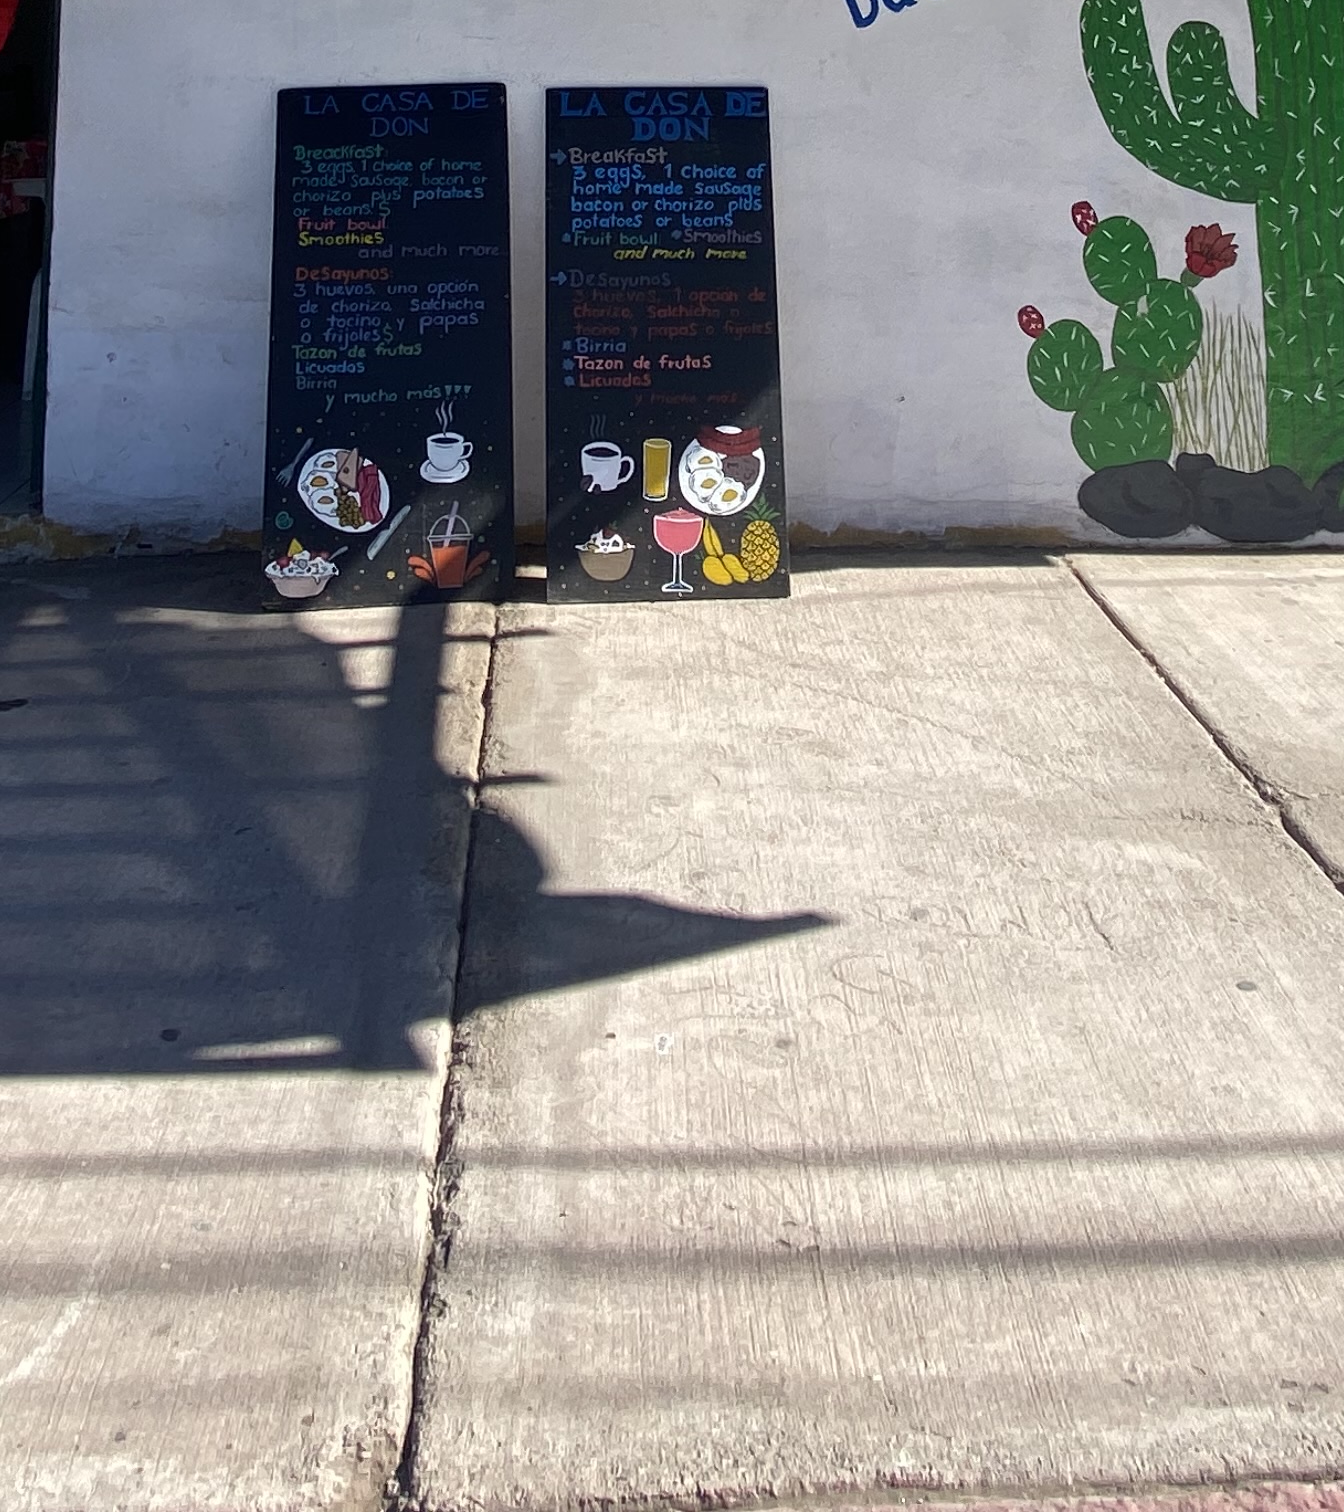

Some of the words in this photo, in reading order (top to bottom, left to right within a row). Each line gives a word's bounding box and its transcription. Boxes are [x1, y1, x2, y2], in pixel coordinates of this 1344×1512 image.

[304, 95, 340, 114] LA
[361, 92, 433, 112] CASA
[451, 89, 488, 110] DE
[560, 92, 606, 117] LA
[624, 91, 713, 116] CASA
[725, 91, 768, 117] DE
[370, 117, 428, 137] DON
[631, 117, 710, 142] DON
[568, 147, 668, 164] Breakfast
[301, 161, 312, 173] 3
[362, 160, 366, 171] 1
[420, 159, 435, 171] of
[442, 159, 482, 171] home
[573, 165, 586, 179] 3
[664, 165, 671, 178] 1
[746, 164, 766, 178] of
[292, 175, 338, 187] made
[422, 173, 464, 185] bacon
[472, 175, 488, 184] or
[573, 181, 622, 195] home
[635, 182, 684, 195] made
[293, 189, 351, 203] chorizo
[372, 188, 401, 208] plus
[413, 188, 484, 208] potatoes
[571, 198, 623, 212] bacon
[632, 201, 648, 211] or
[655, 199, 714, 212] chorizo
[728, 197, 762, 213] plus
[293, 206, 310, 217] or
[298, 217, 335, 231] Fruit
[572, 214, 642, 232] potatoes
[656, 216, 672, 227] or
[682, 213, 733, 227] beans
[298, 232, 384, 246] Smoothies
[574, 231, 612, 246] Fruit
[620, 233, 658, 245] bowl
[683, 229, 762, 243] Smoothies
[358, 245, 393, 258] and
[401, 244, 447, 257] much
[459, 246, 499, 257] more
[613, 246, 647, 260] and
[652, 248, 695, 259] much
[706, 248, 747, 259] more
[568, 269, 671, 289] Desayunos
[293, 284, 306, 297] 3
[387, 284, 417, 294] una
[427, 280, 479, 297] opción
[748, 289, 766, 302] de
[299, 300, 318, 314] de
[300, 318, 310, 329] o
[396, 317, 404, 331] y
[420, 313, 479, 334] papas
[648, 323, 697, 339] papas
[300, 333, 311, 343] o
[323, 328, 381, 350] frijoles
[575, 338, 627, 353] Birria
[292, 345, 337, 360] Tazon
[348, 346, 366, 358] de
[375, 344, 422, 356] frutas
[296, 361, 365, 374] Licuados
[574, 355, 623, 371] Tazon
[633, 355, 651, 370] de
[659, 355, 712, 369] frutas
[296, 377, 337, 390] Birria
[579, 373, 651, 388] Licuados
[325, 394, 334, 413] y
[344, 390, 397, 404] mucho
